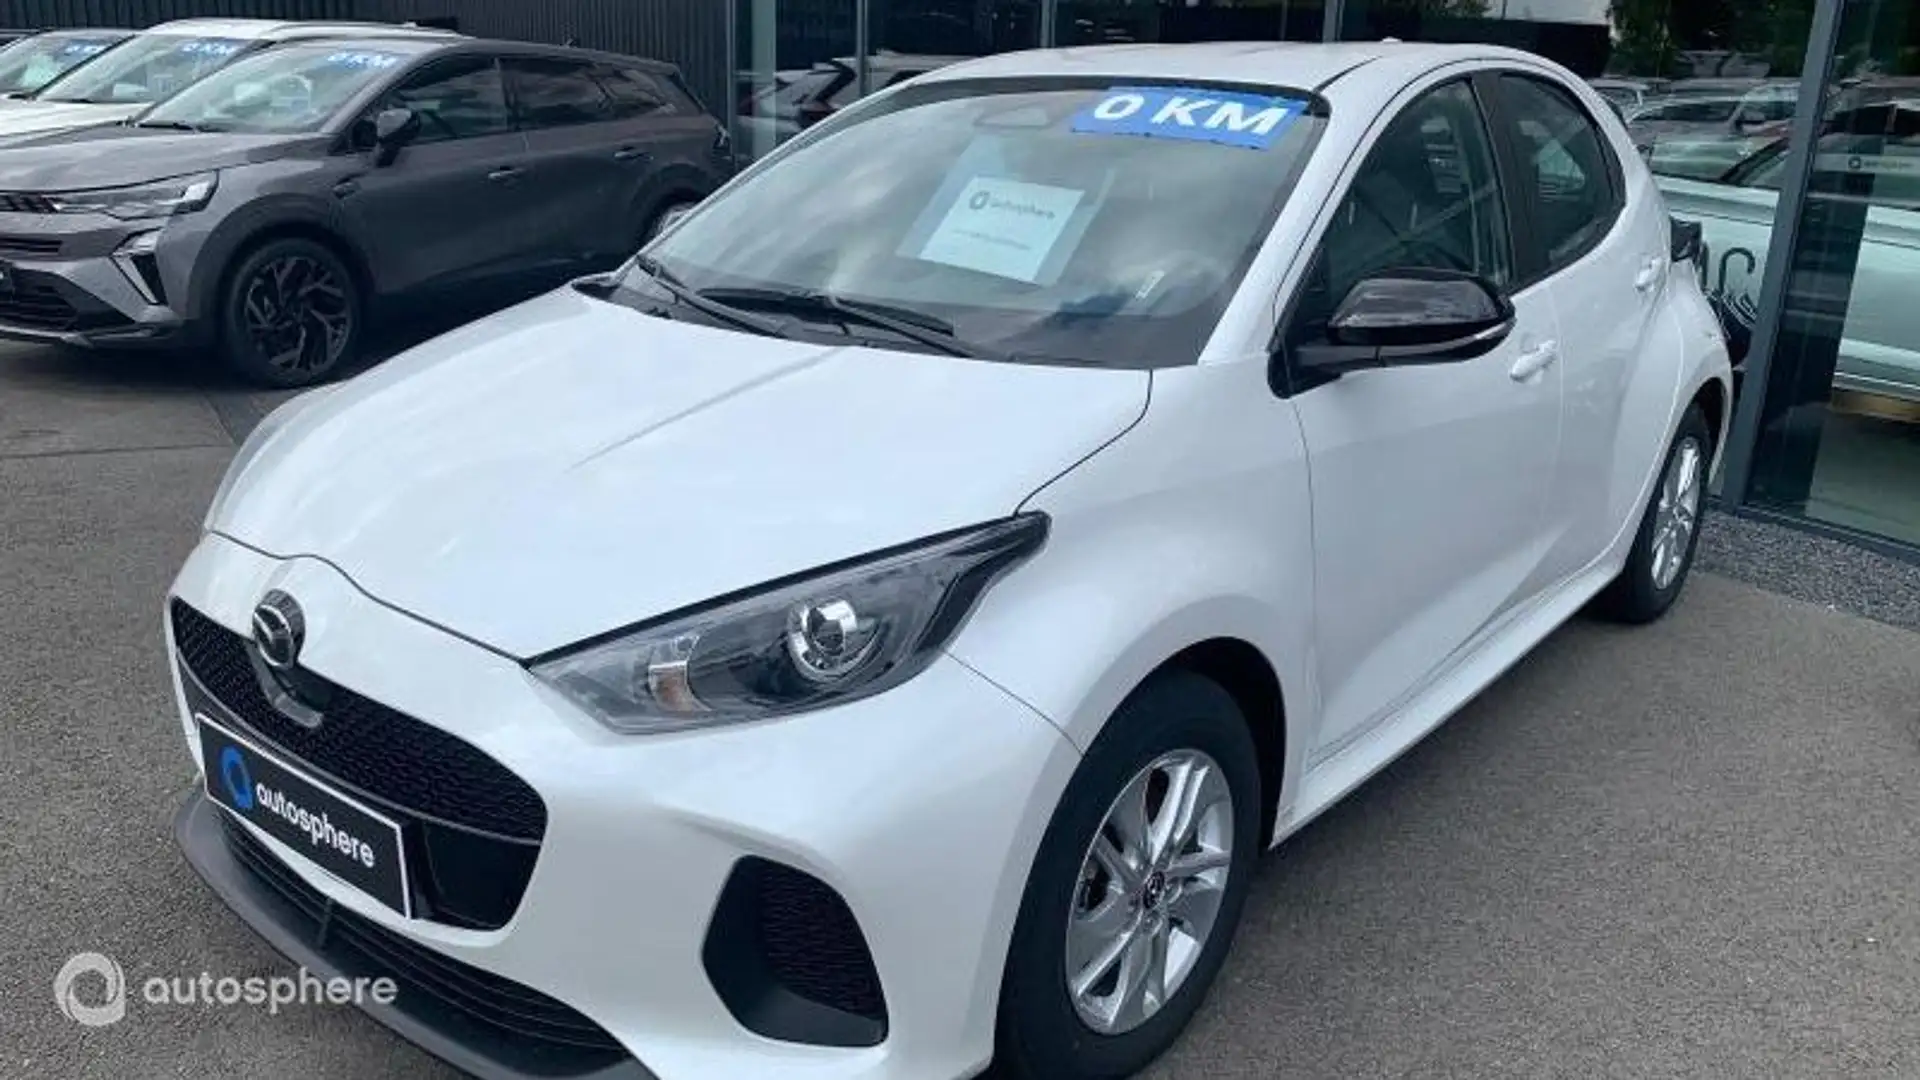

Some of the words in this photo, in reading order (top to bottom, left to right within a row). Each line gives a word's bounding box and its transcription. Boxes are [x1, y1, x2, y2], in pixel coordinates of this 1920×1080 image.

[1094, 93, 1145, 120] 0
[1151, 95, 1291, 136] KM
[256, 782, 375, 869] autosphere
